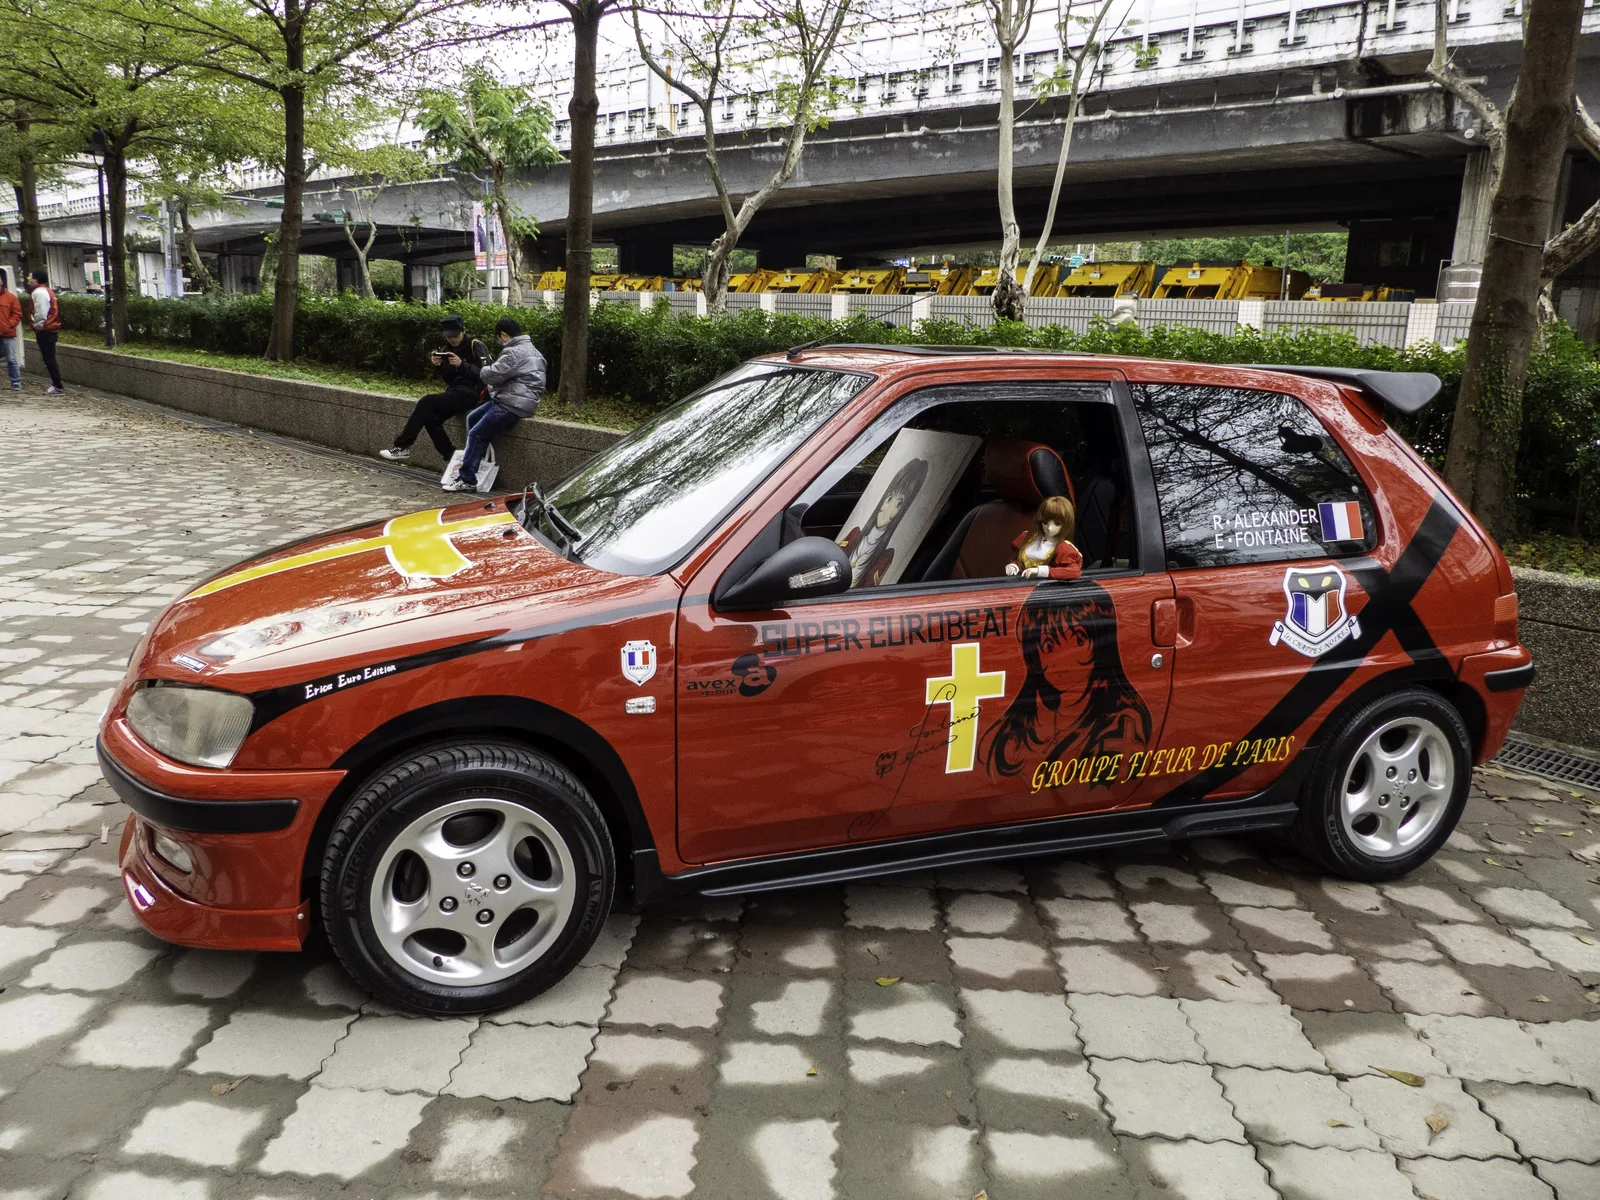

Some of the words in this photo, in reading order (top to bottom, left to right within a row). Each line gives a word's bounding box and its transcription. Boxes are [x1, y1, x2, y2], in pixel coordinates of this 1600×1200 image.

[1234, 508, 1319, 528] ALEXANDER
[1235, 527, 1310, 547] FONTAINE
[762, 618, 865, 658] SUPER
[867, 606, 1013, 649] EUROBEAT
[304, 683, 333, 700] Erica
[337, 673, 362, 688] Euro
[363, 664, 397, 680] Edition
[687, 678, 737, 691] avex
[702, 688, 737, 697] group
[1031, 753, 1124, 794] GROUPE
[1120, 745, 1196, 784] FLEUR
[1198, 741, 1232, 771] DE
[1232, 735, 1296, 766] PARIS
